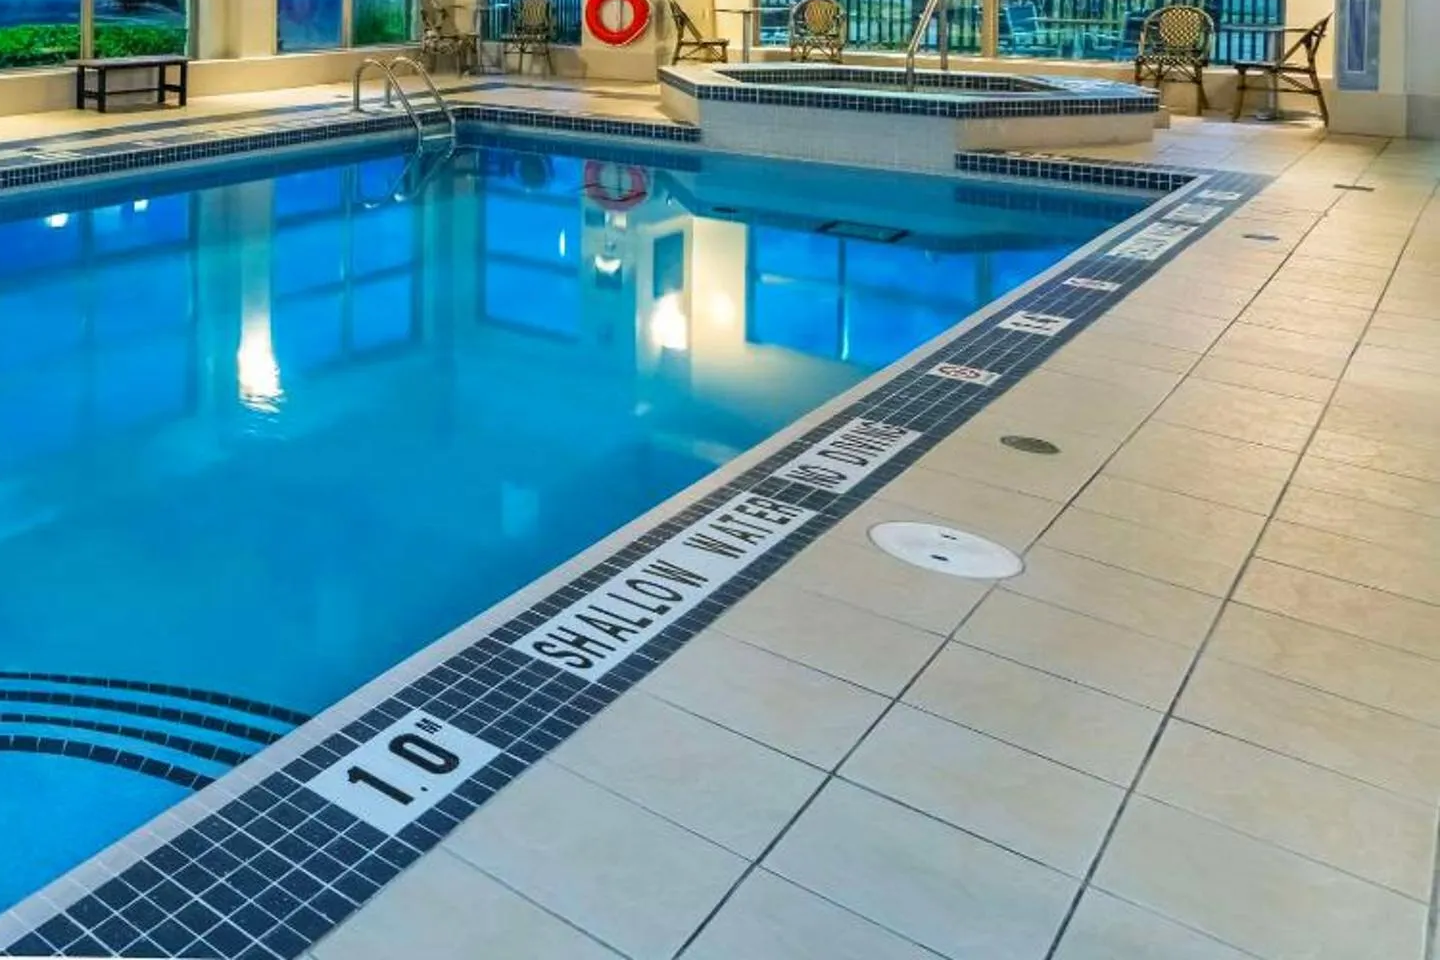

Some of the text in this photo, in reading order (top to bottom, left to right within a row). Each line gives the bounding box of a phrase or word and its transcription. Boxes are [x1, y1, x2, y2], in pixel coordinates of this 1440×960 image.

[785, 420, 907, 488] NO DIVING
[531, 496, 804, 670] SHALLOW WATER
